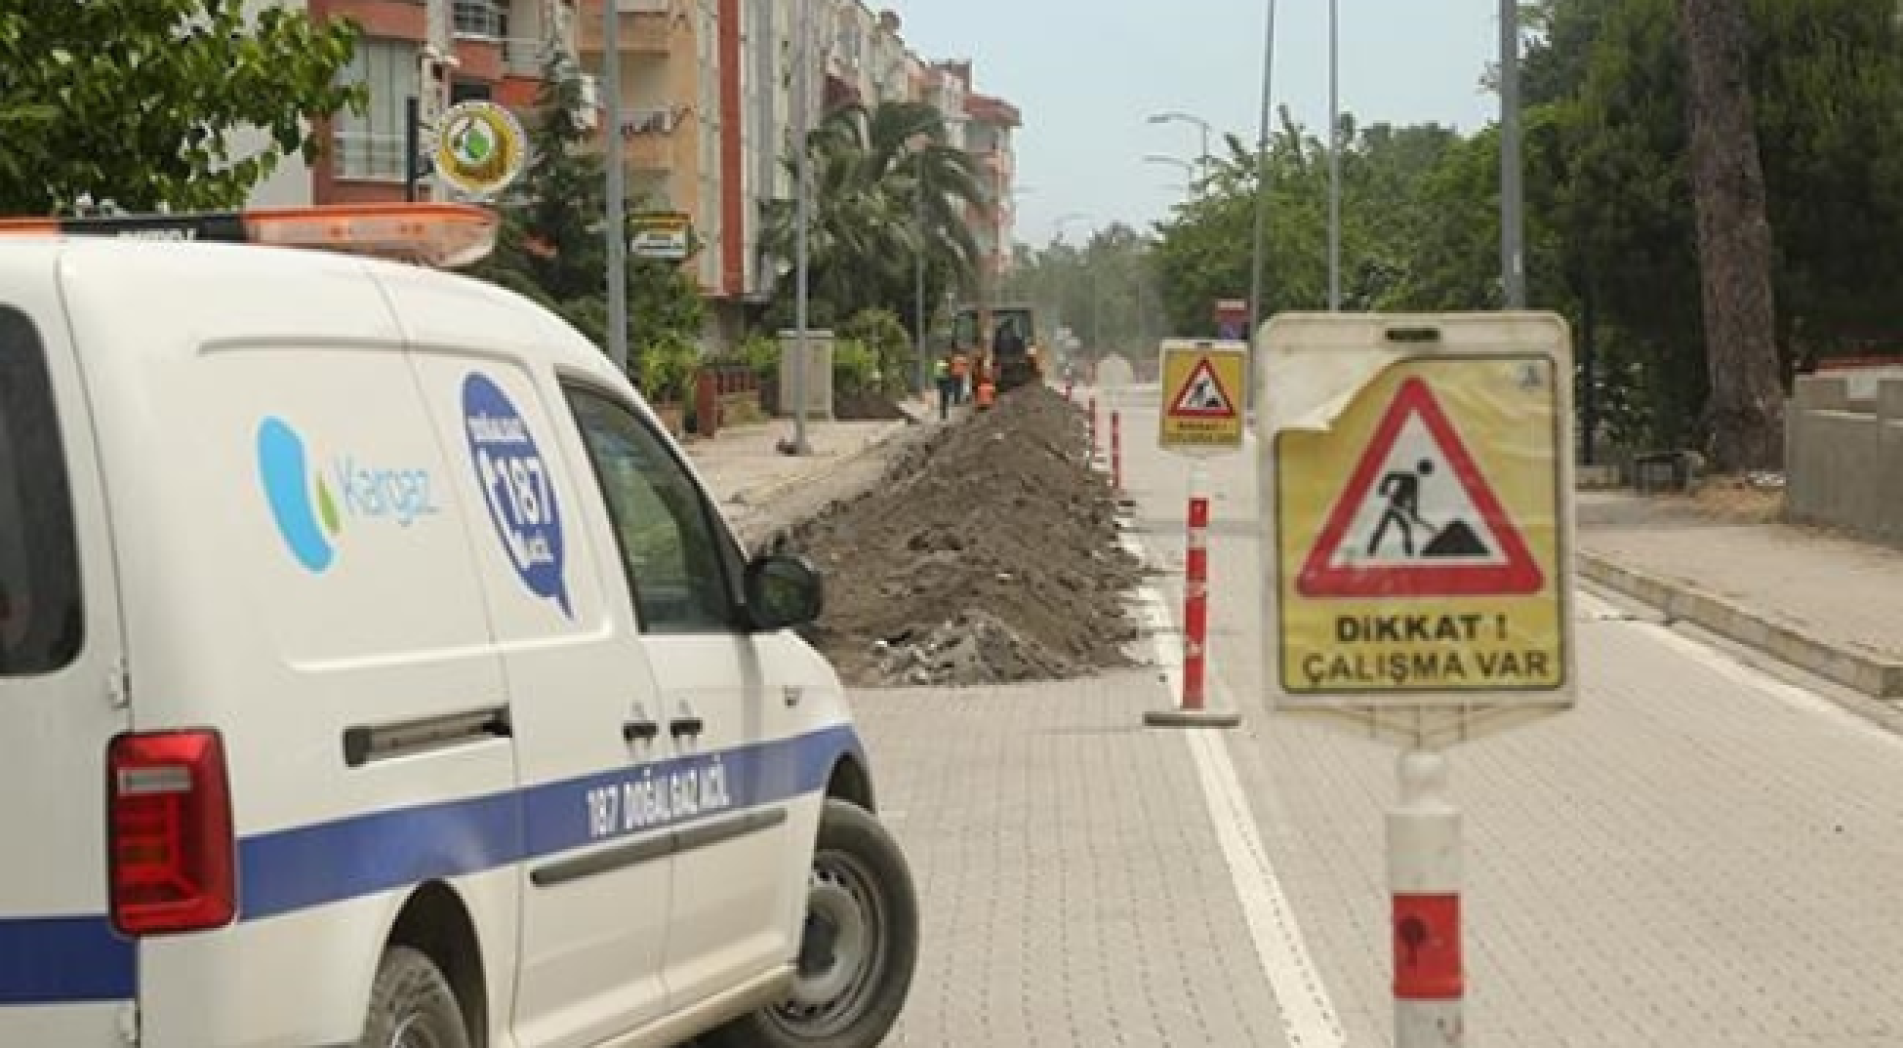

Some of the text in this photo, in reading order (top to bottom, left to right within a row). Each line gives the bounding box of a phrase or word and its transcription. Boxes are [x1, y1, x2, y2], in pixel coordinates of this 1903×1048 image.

[493, 457, 552, 525] 187
[1303, 649, 1549, 685] ÇALIŞMA VAR
[586, 785, 619, 838] 187
